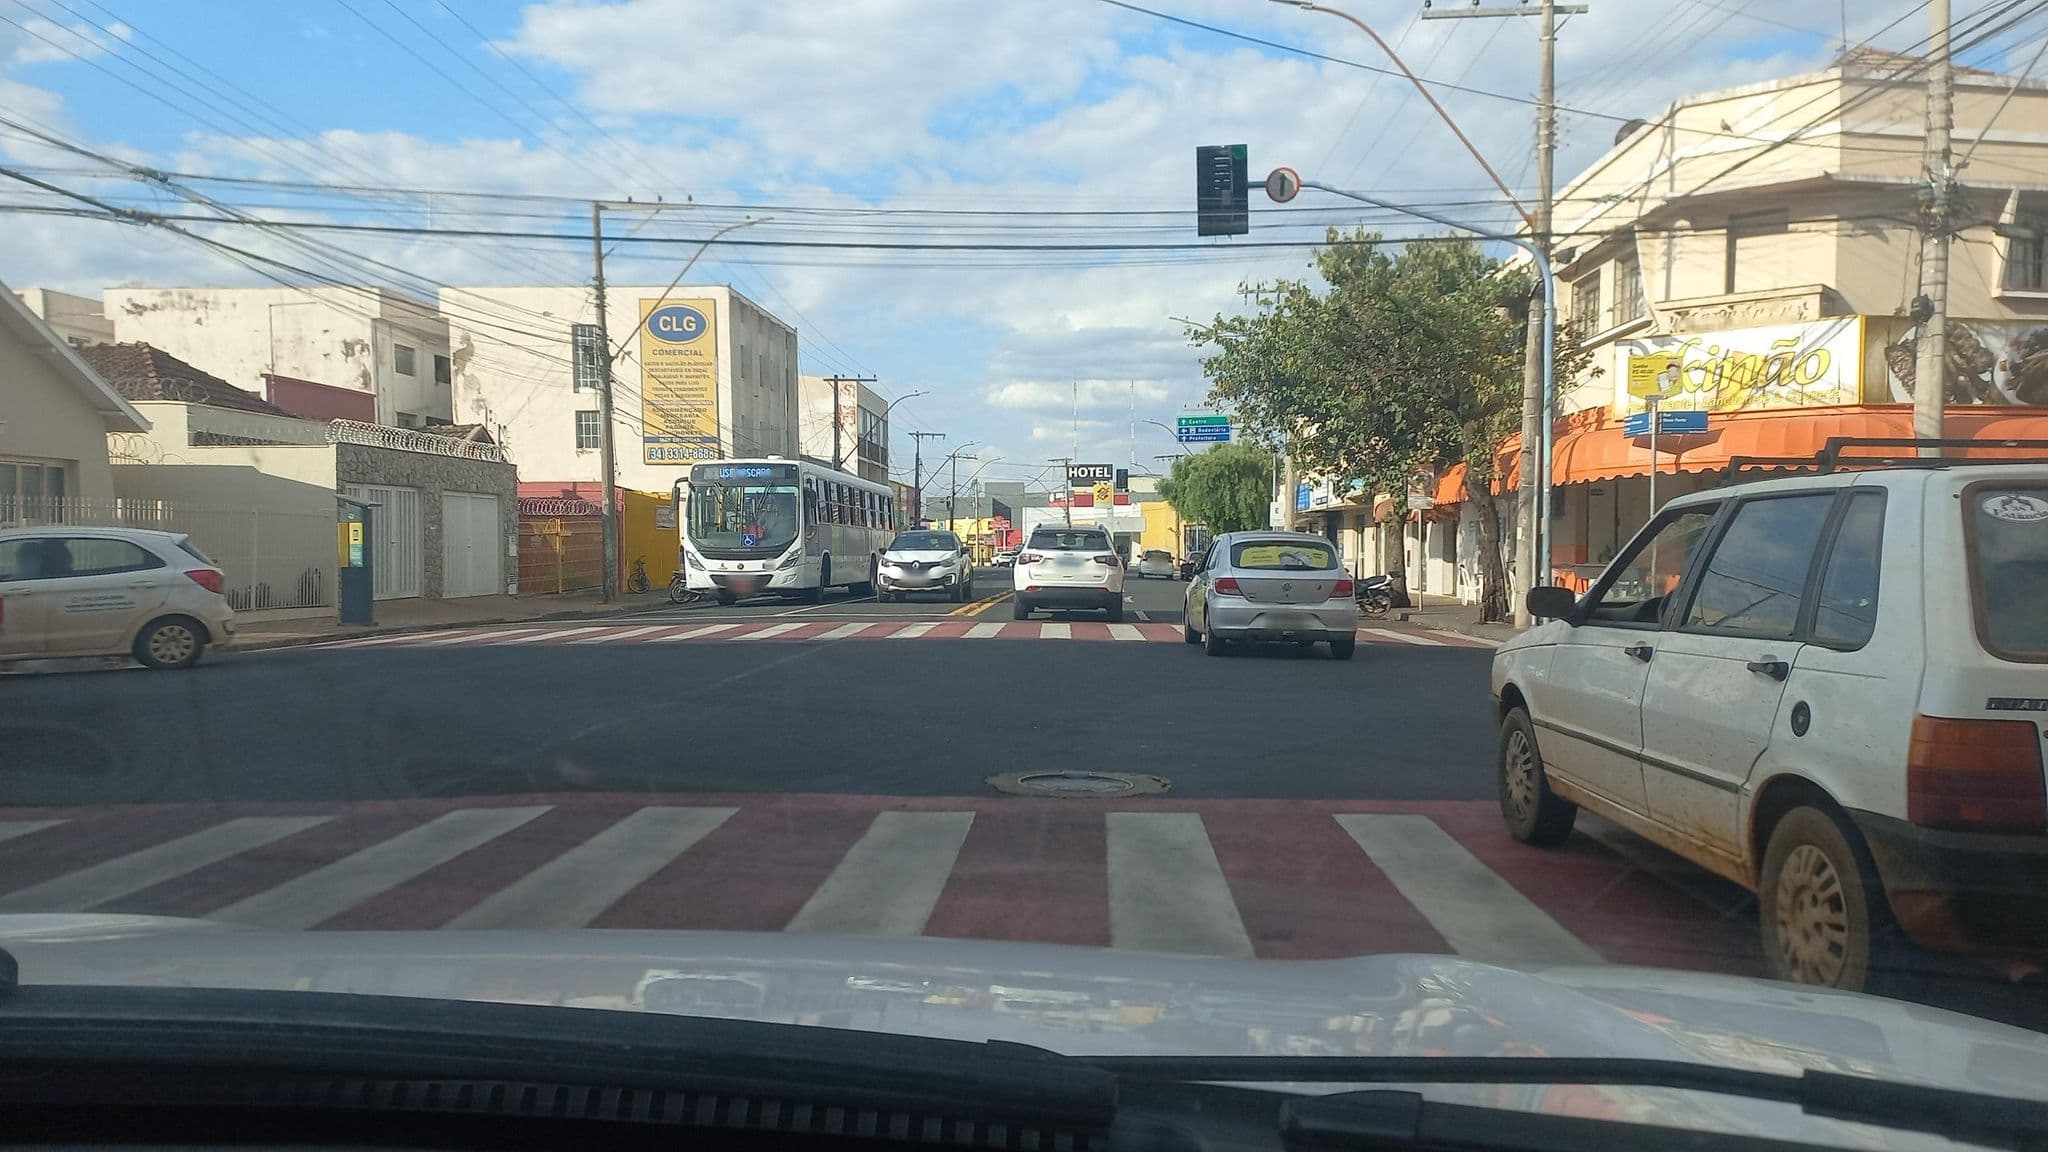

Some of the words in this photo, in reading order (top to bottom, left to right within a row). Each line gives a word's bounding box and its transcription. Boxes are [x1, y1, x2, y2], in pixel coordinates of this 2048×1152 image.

[658, 315, 697, 332] CLG
[652, 348, 704, 357] COMERCIAL
[647, 446, 666, 460] (34)
[1068, 466, 1112, 478] HOTEL
